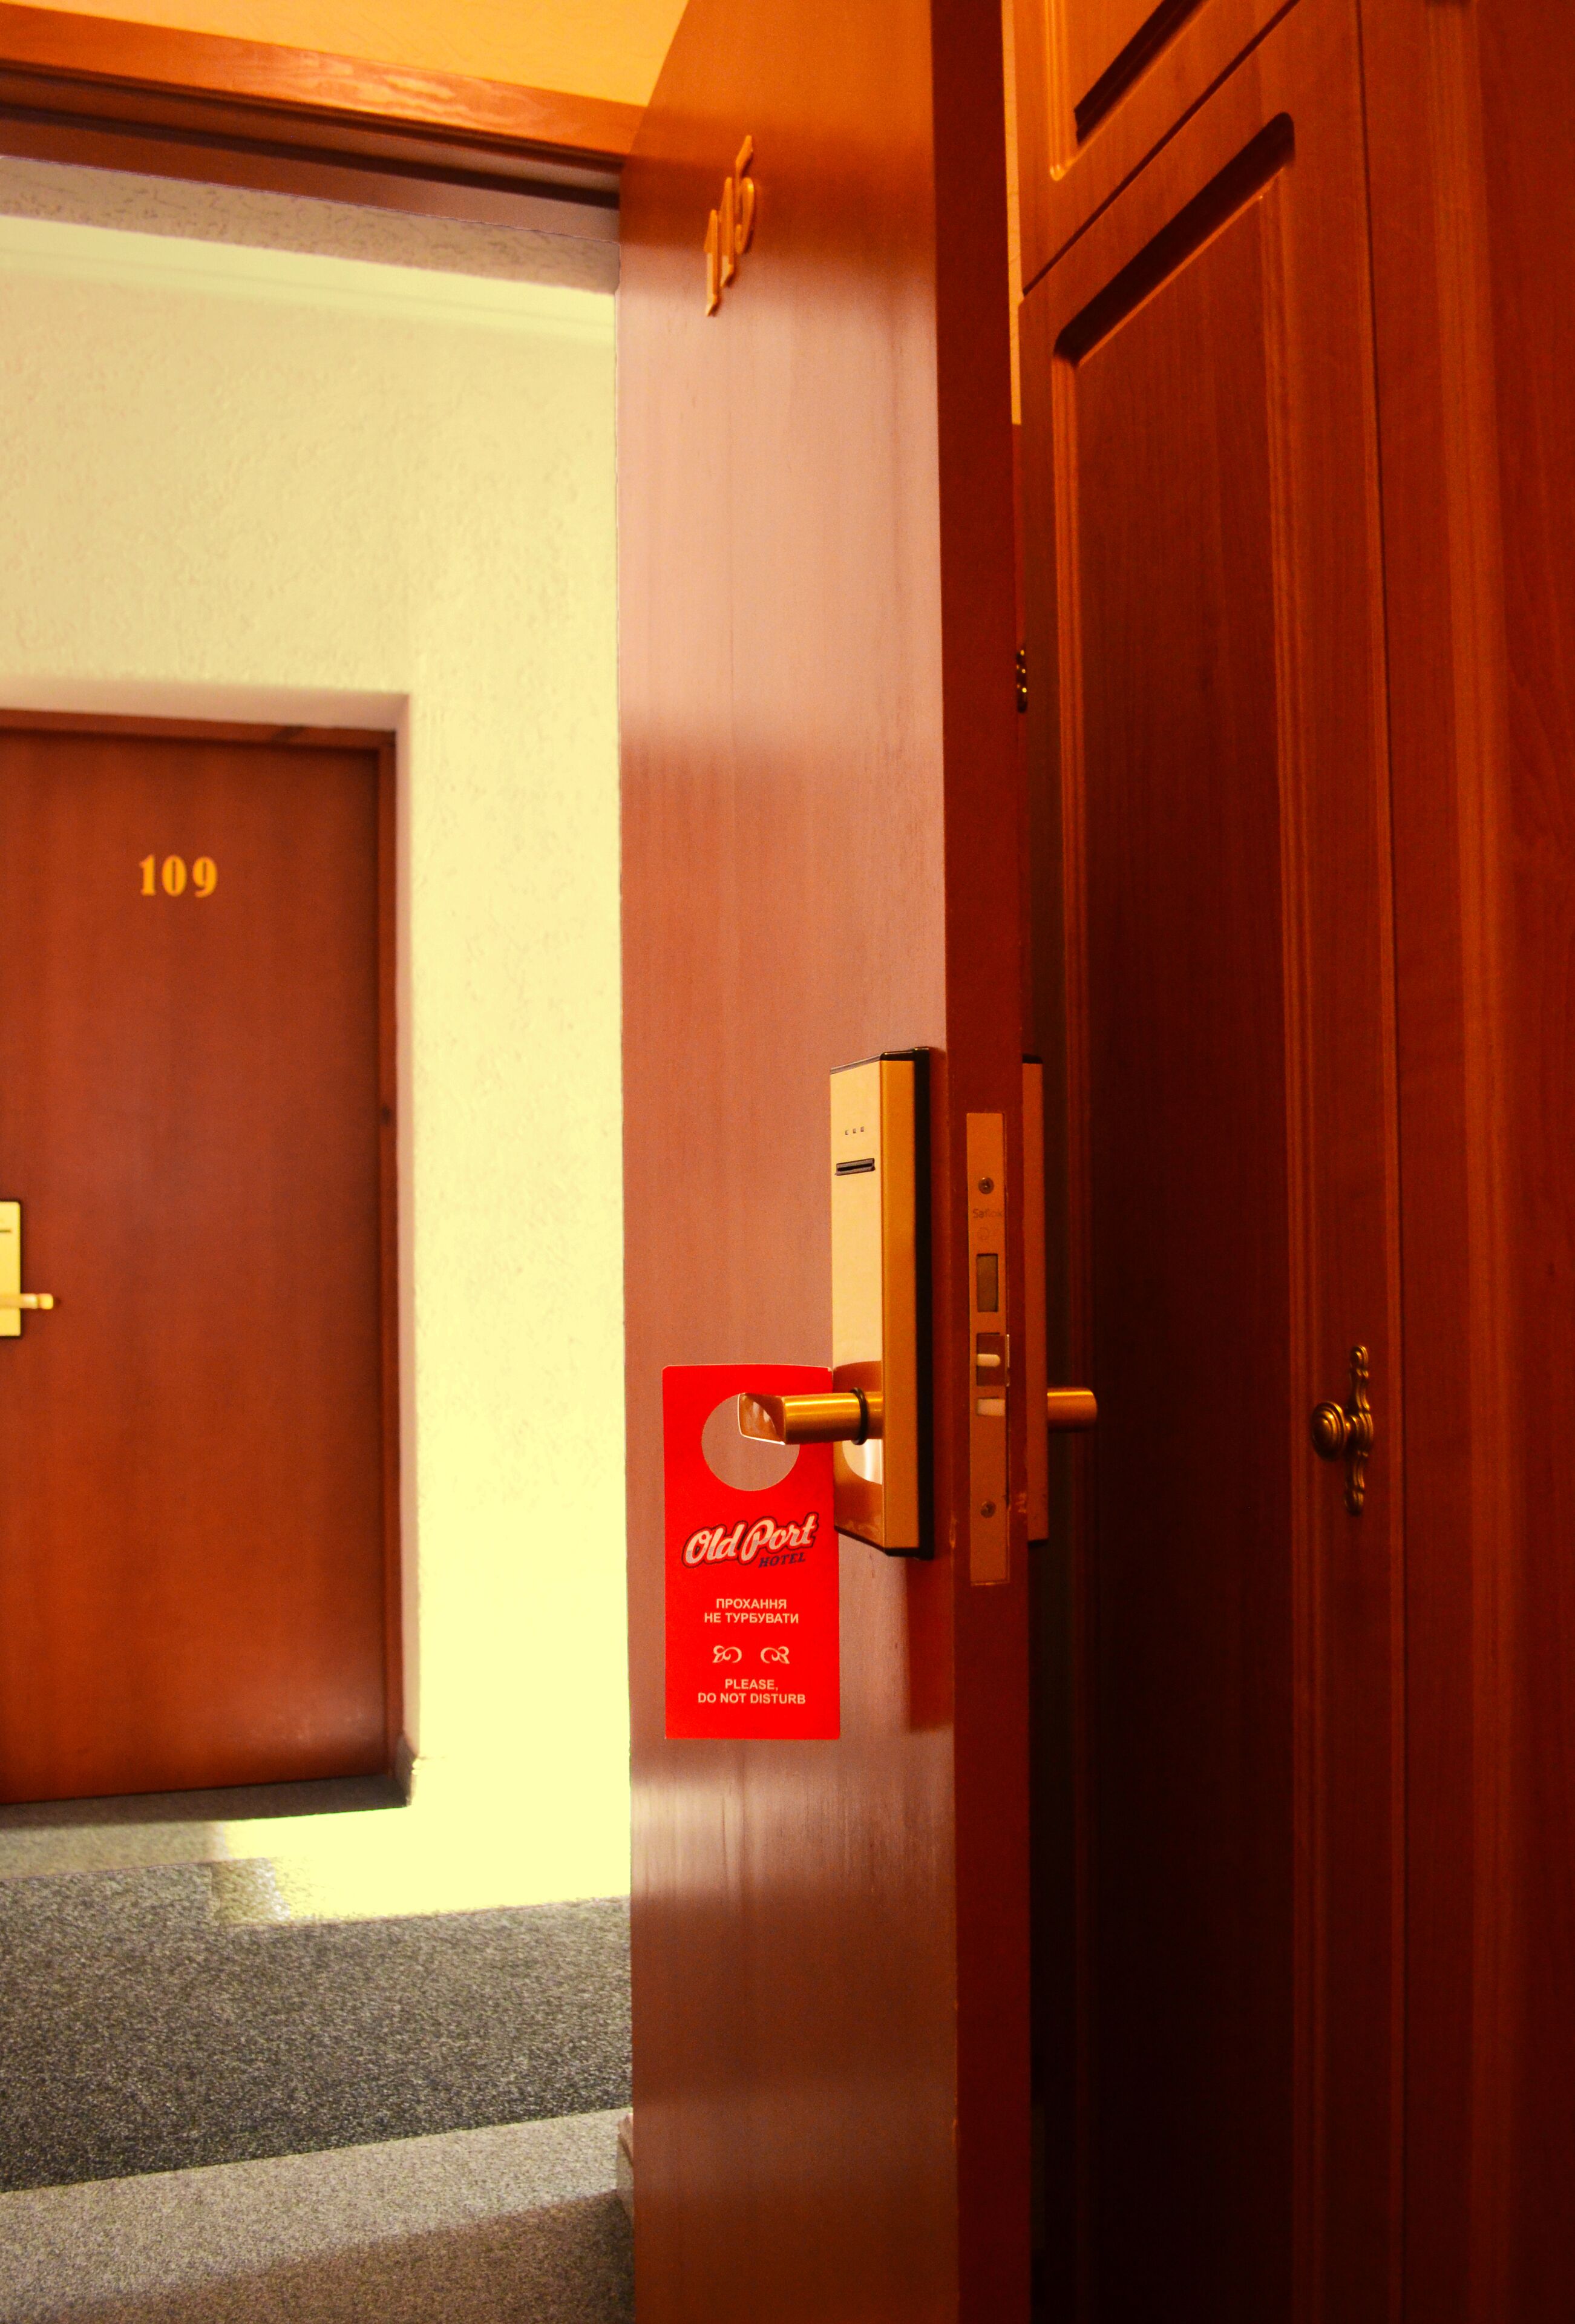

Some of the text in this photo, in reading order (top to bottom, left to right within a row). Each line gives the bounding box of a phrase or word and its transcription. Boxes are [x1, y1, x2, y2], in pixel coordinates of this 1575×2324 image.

[703, 134, 755, 317] 115
[139, 854, 218, 898] 109
[684, 1514, 817, 1566] Old Port
[758, 1552, 806, 1569] HOTEL
[716, 1598, 787, 1609] ПРОХАННЯ
[704, 1612, 799, 1624] НЕ ТУРБУВАТИ
[725, 1678, 779, 1691] PLEASE,
[698, 1692, 806, 1705] DO NOT DISTURB
